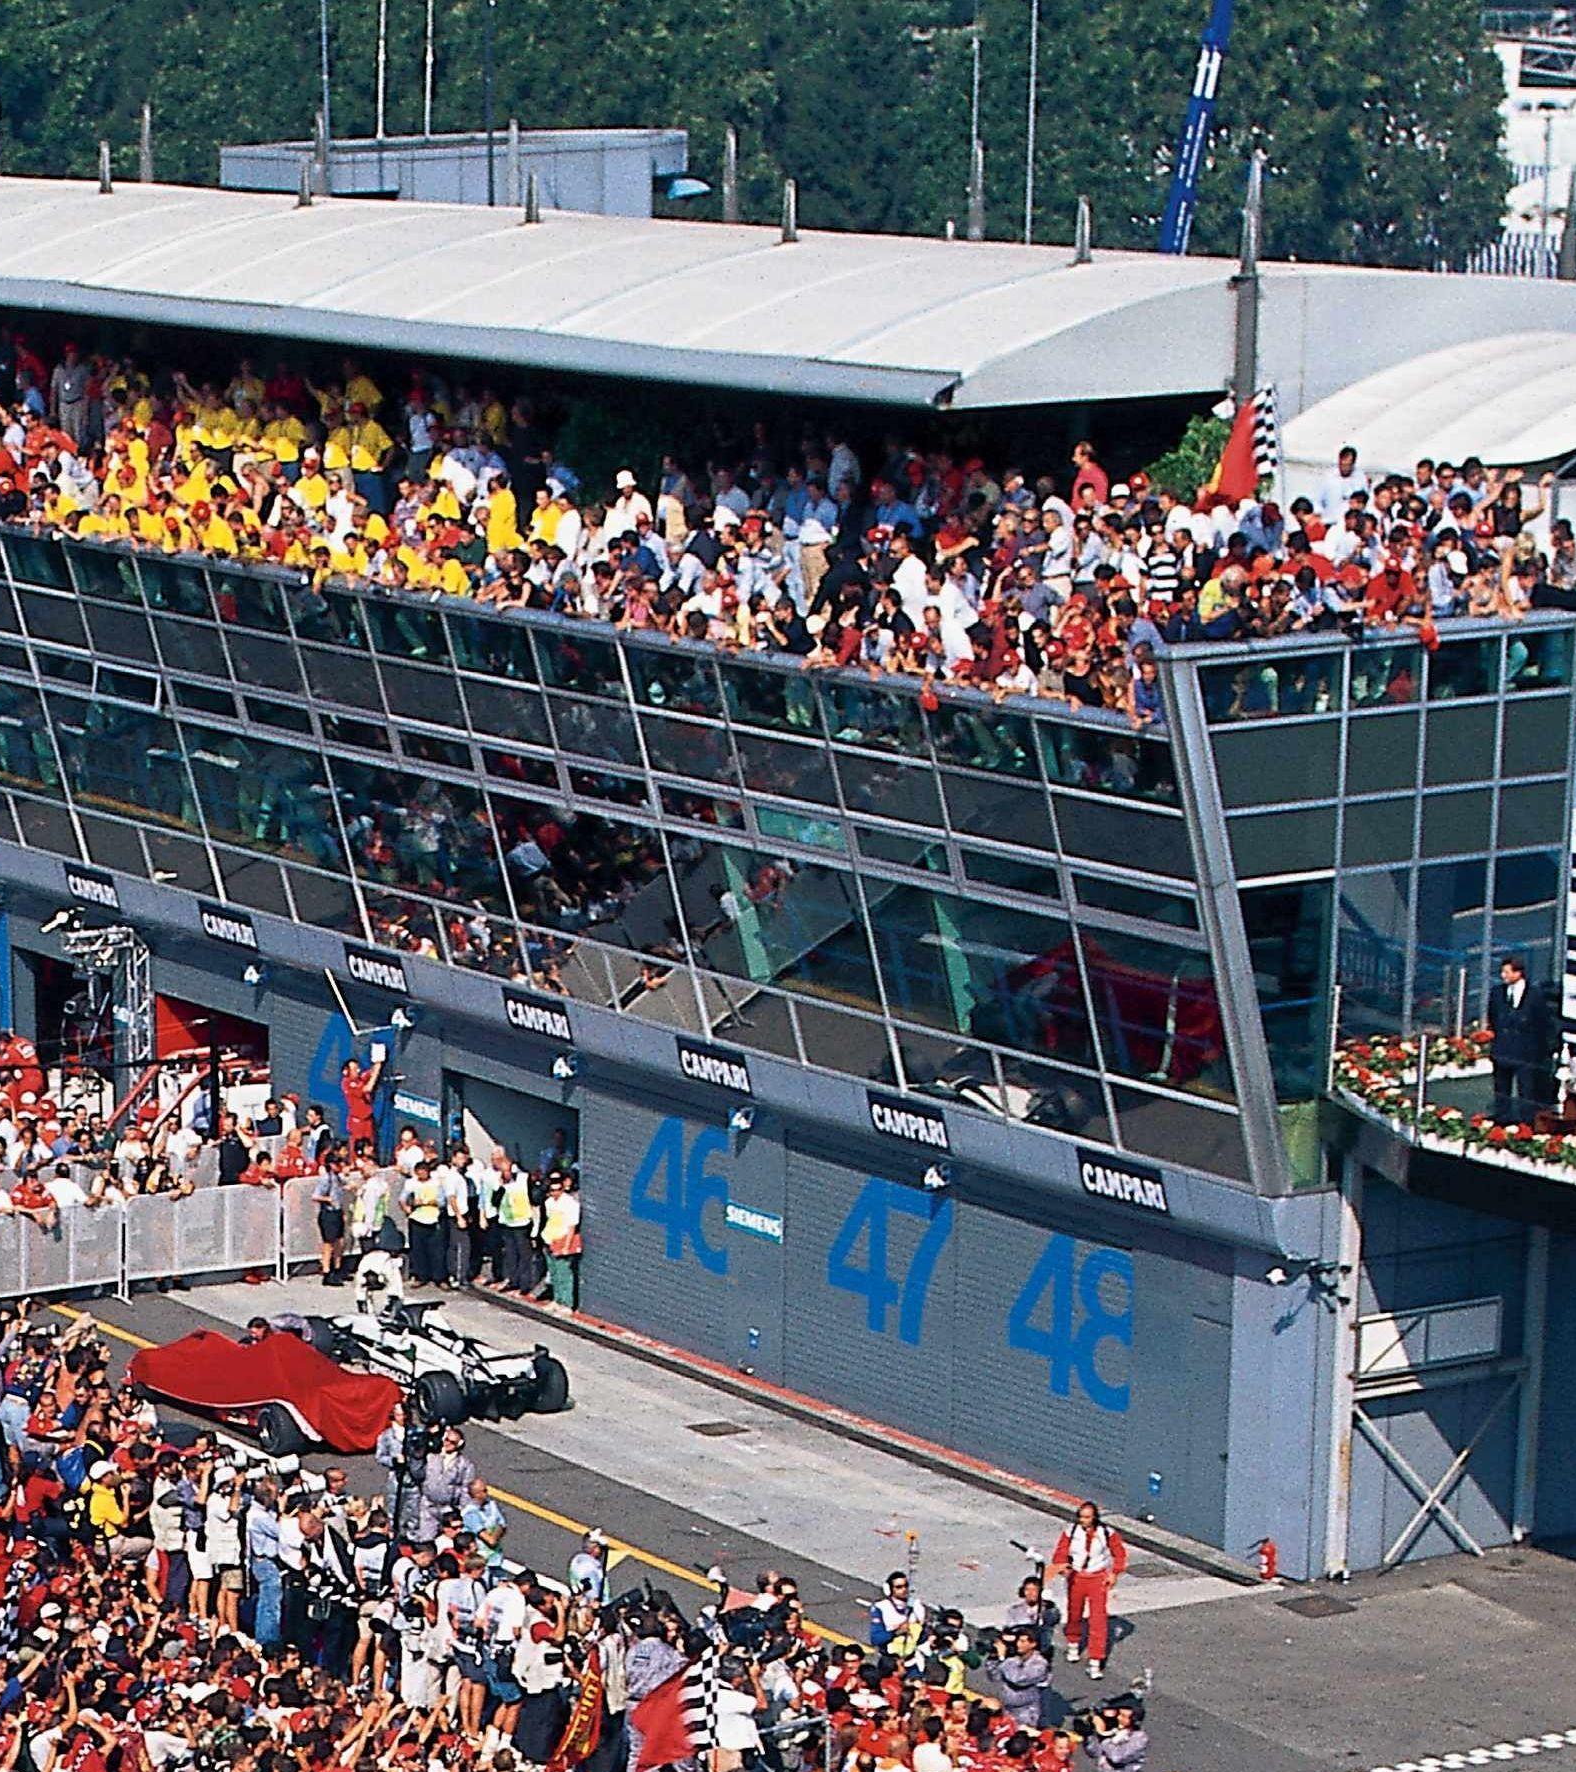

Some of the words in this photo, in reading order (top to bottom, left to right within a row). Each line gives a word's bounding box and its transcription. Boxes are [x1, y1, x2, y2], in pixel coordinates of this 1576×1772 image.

[348, 954, 407, 992] CAMPARI
[507, 999, 571, 1040] CAMPARI
[681, 1050, 750, 1092] CAMPARI
[872, 1103, 948, 1148] CAMPARI
[1082, 1162, 1167, 1211] CAMPARI
[726, 1205, 783, 1238] SIEMENS
[827, 1177, 954, 1346] 47
[1007, 1234, 1134, 1412] 48
